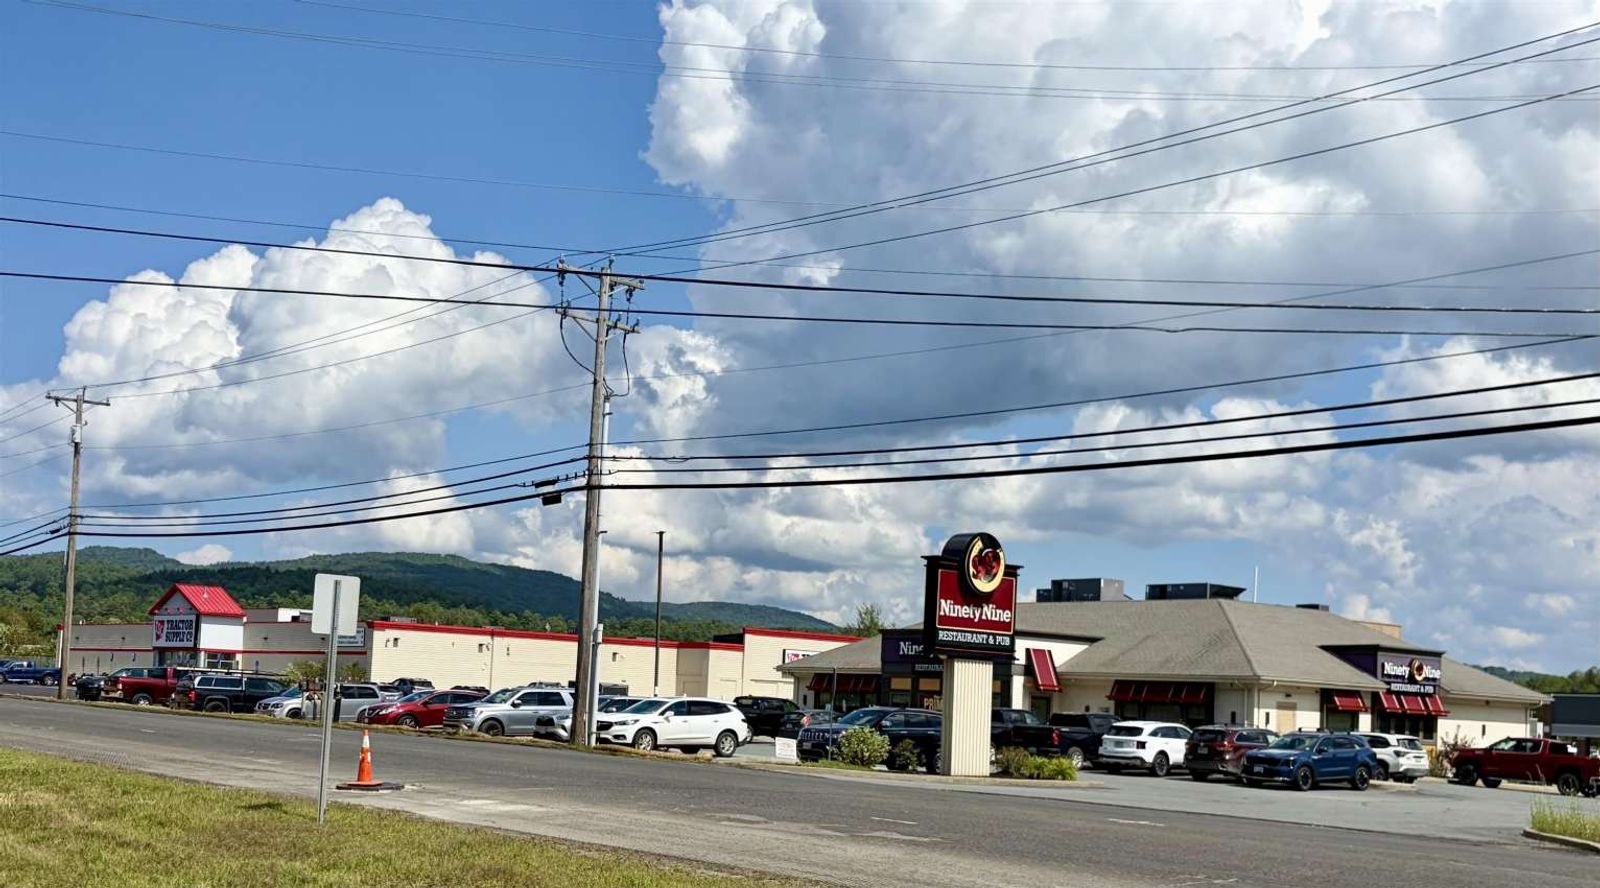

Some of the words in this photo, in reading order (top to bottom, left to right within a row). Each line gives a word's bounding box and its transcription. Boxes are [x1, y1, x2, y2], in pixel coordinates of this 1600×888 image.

[939, 599, 981, 622] Ninety
[981, 603, 1012, 622] Nine
[166, 619, 194, 631] TRACTOR
[165, 631, 185, 643] SUPPLY
[938, 630, 987, 644] RESTAURANT
[987, 635, 995, 645] &
[995, 636, 1011, 646] PUB
[1383, 661, 1410, 679] Ninety
[1423, 665, 1441, 679] Nine
